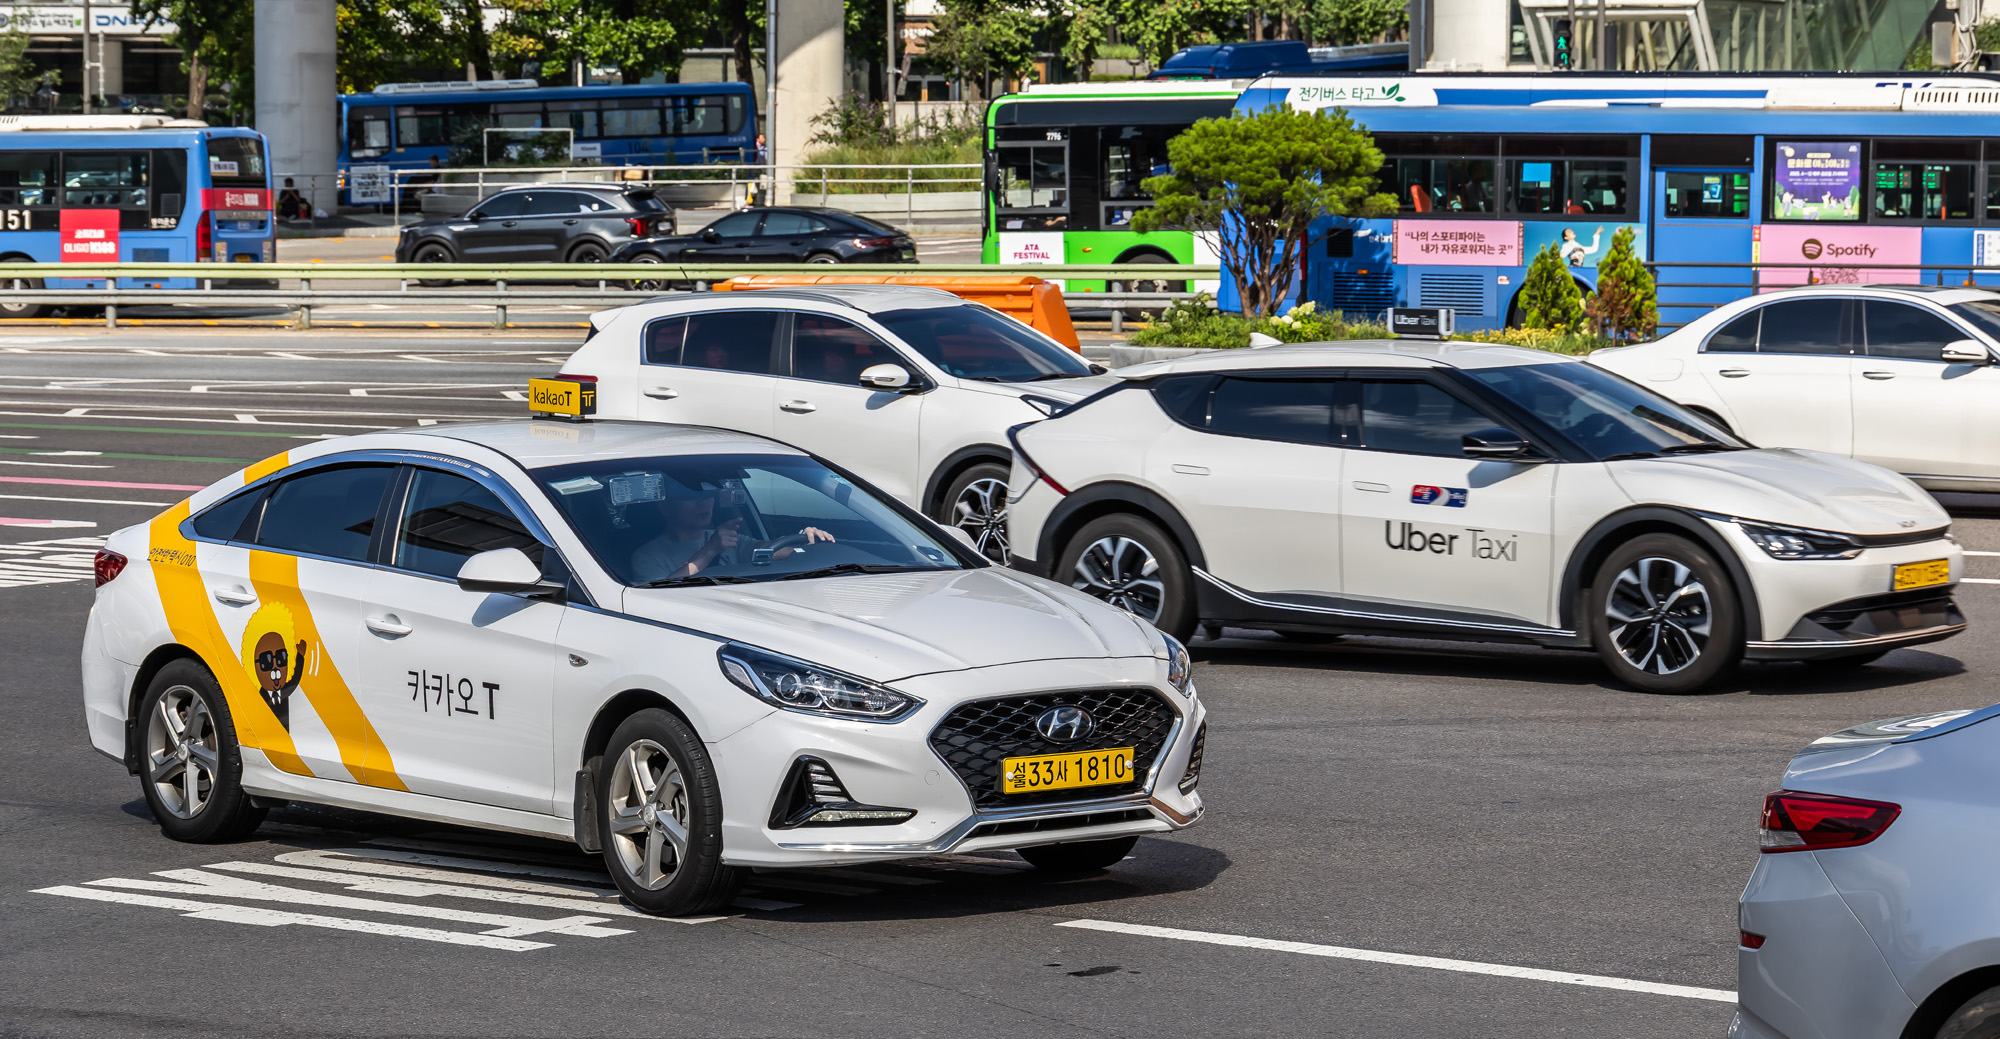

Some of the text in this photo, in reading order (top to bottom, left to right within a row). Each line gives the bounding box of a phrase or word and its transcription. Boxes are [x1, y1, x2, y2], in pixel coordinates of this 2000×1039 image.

[1299, 87, 1376, 102] 전기버스 타고
[1431, 231, 1485, 243] 스포티파이는
[1024, 243, 1039, 251] ATA
[1421, 243, 1439, 255] 내가
[1441, 243, 1495, 255] 자유로워지는
[1826, 243, 1876, 258] Spotify
[1013, 252, 1050, 260] FESTIVAL
[1394, 314, 1437, 326] Uber Taxi
[1384, 520, 1518, 562] Uber Taxi
[407, 669, 500, 720] 카카오 T
[1074, 753, 1125, 782] 1810
